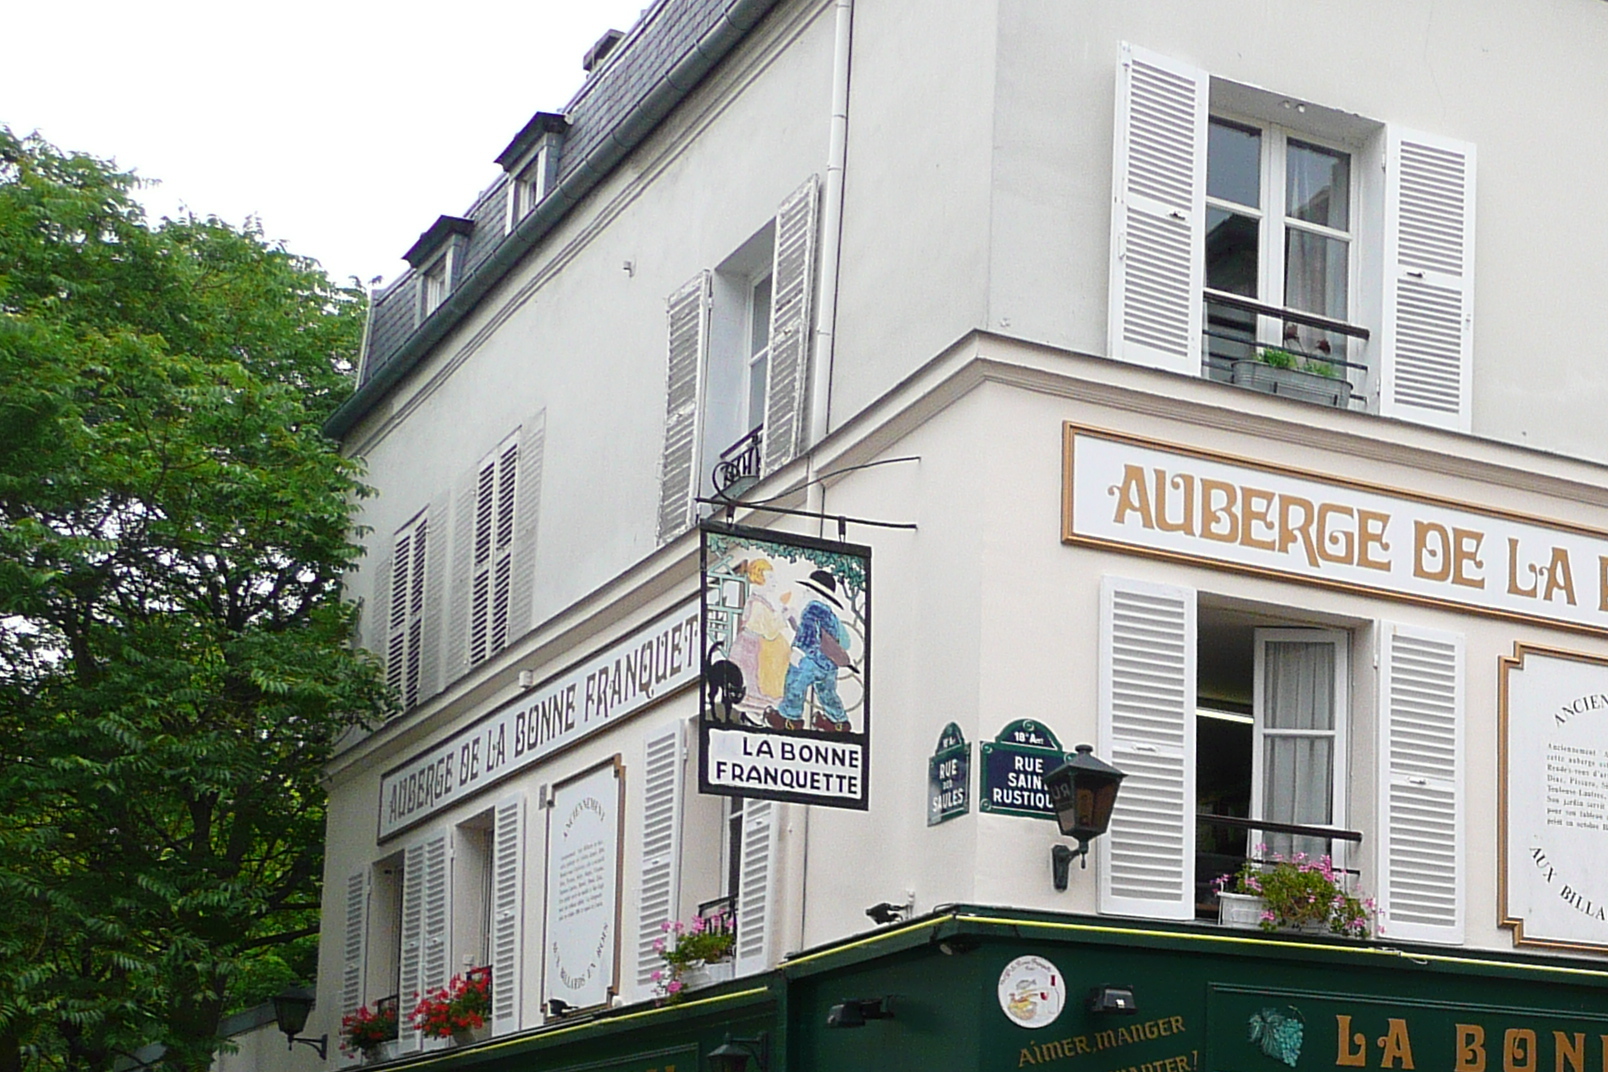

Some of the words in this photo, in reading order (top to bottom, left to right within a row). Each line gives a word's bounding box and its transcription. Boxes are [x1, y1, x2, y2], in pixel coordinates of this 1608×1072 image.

[1107, 463, 1392, 572] AUBERGE
[1412, 518, 1486, 590] DE
[1507, 538, 1577, 607] LA
[388, 751, 454, 825] AUBERGE
[459, 736, 481, 787] DE
[487, 722, 505, 773] LA
[514, 682, 577, 758] BONNE
[743, 737, 774, 758] LA
[781, 742, 859, 768] BONNE
[1014, 756, 1044, 773] RUE
[716, 761, 857, 794] FRANQUETTE
[939, 760, 957, 779] RUE
[933, 788, 964, 812] SAULES
[1529, 843, 1557, 883] AUX
[1336, 1015, 1415, 1070] LA
